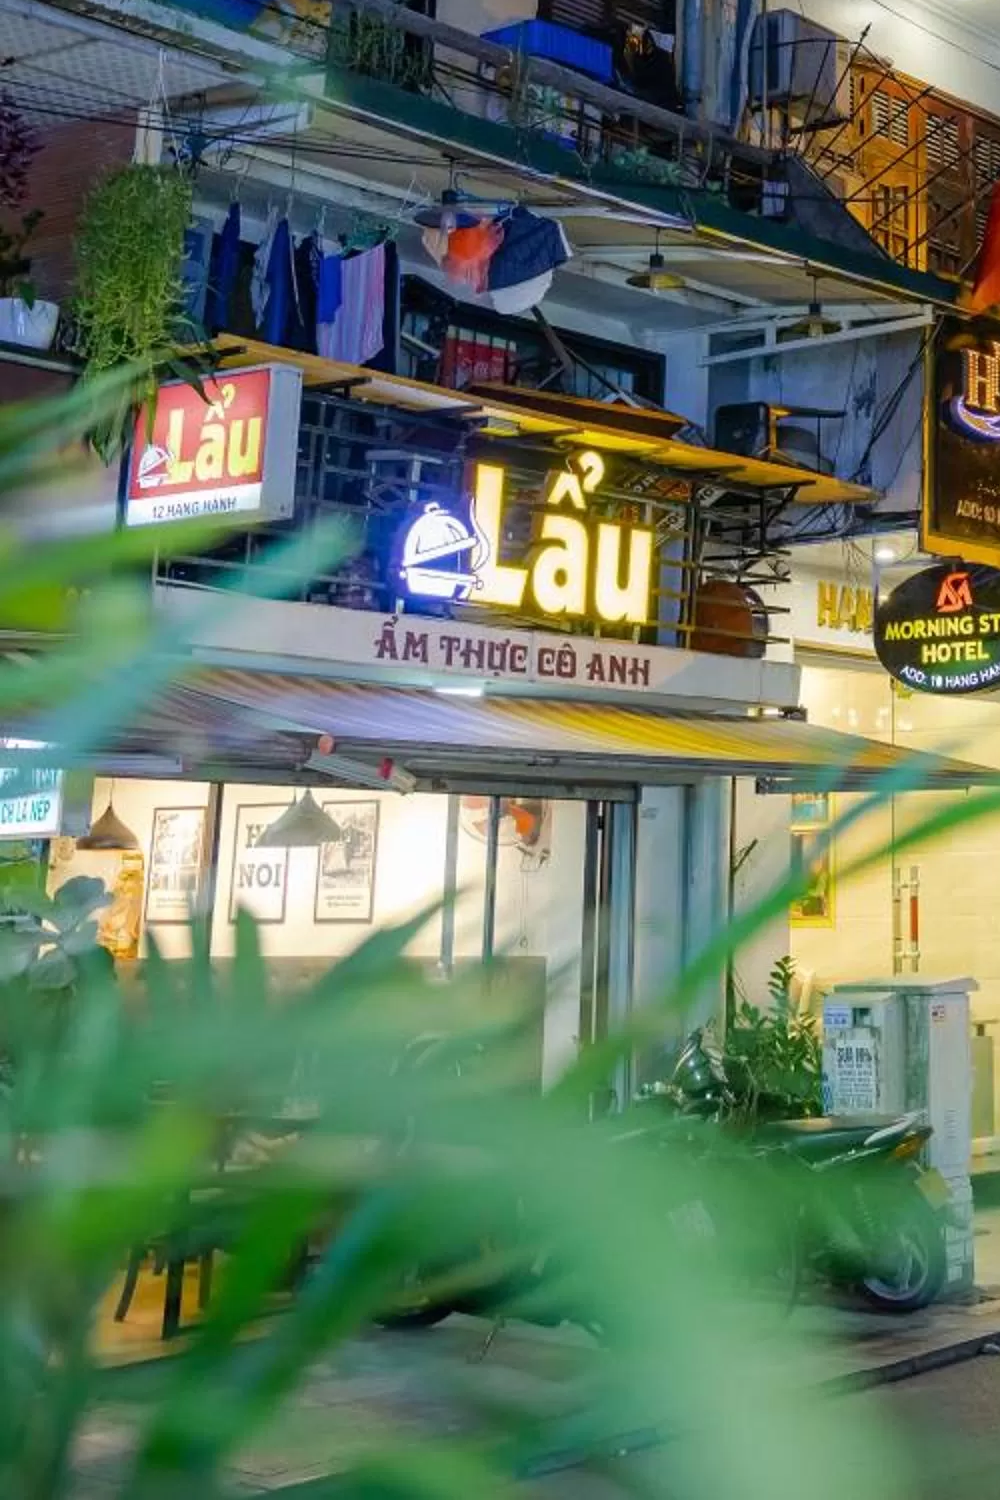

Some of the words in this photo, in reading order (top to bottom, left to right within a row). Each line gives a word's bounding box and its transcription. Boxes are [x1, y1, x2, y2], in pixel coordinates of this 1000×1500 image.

[166, 383, 263, 485] Lẩu
[152, 504, 165, 519] 12
[470, 451, 654, 624] Lẩu
[884, 616, 975, 641] MORNING
[373, 615, 430, 664] ẨM
[439, 634, 530, 677] THỰC
[537, 642, 578, 679] CÔ
[586, 652, 651, 687] ANH
[921, 640, 991, 664] HOTEL
[945, 671, 979, 688] HANG
